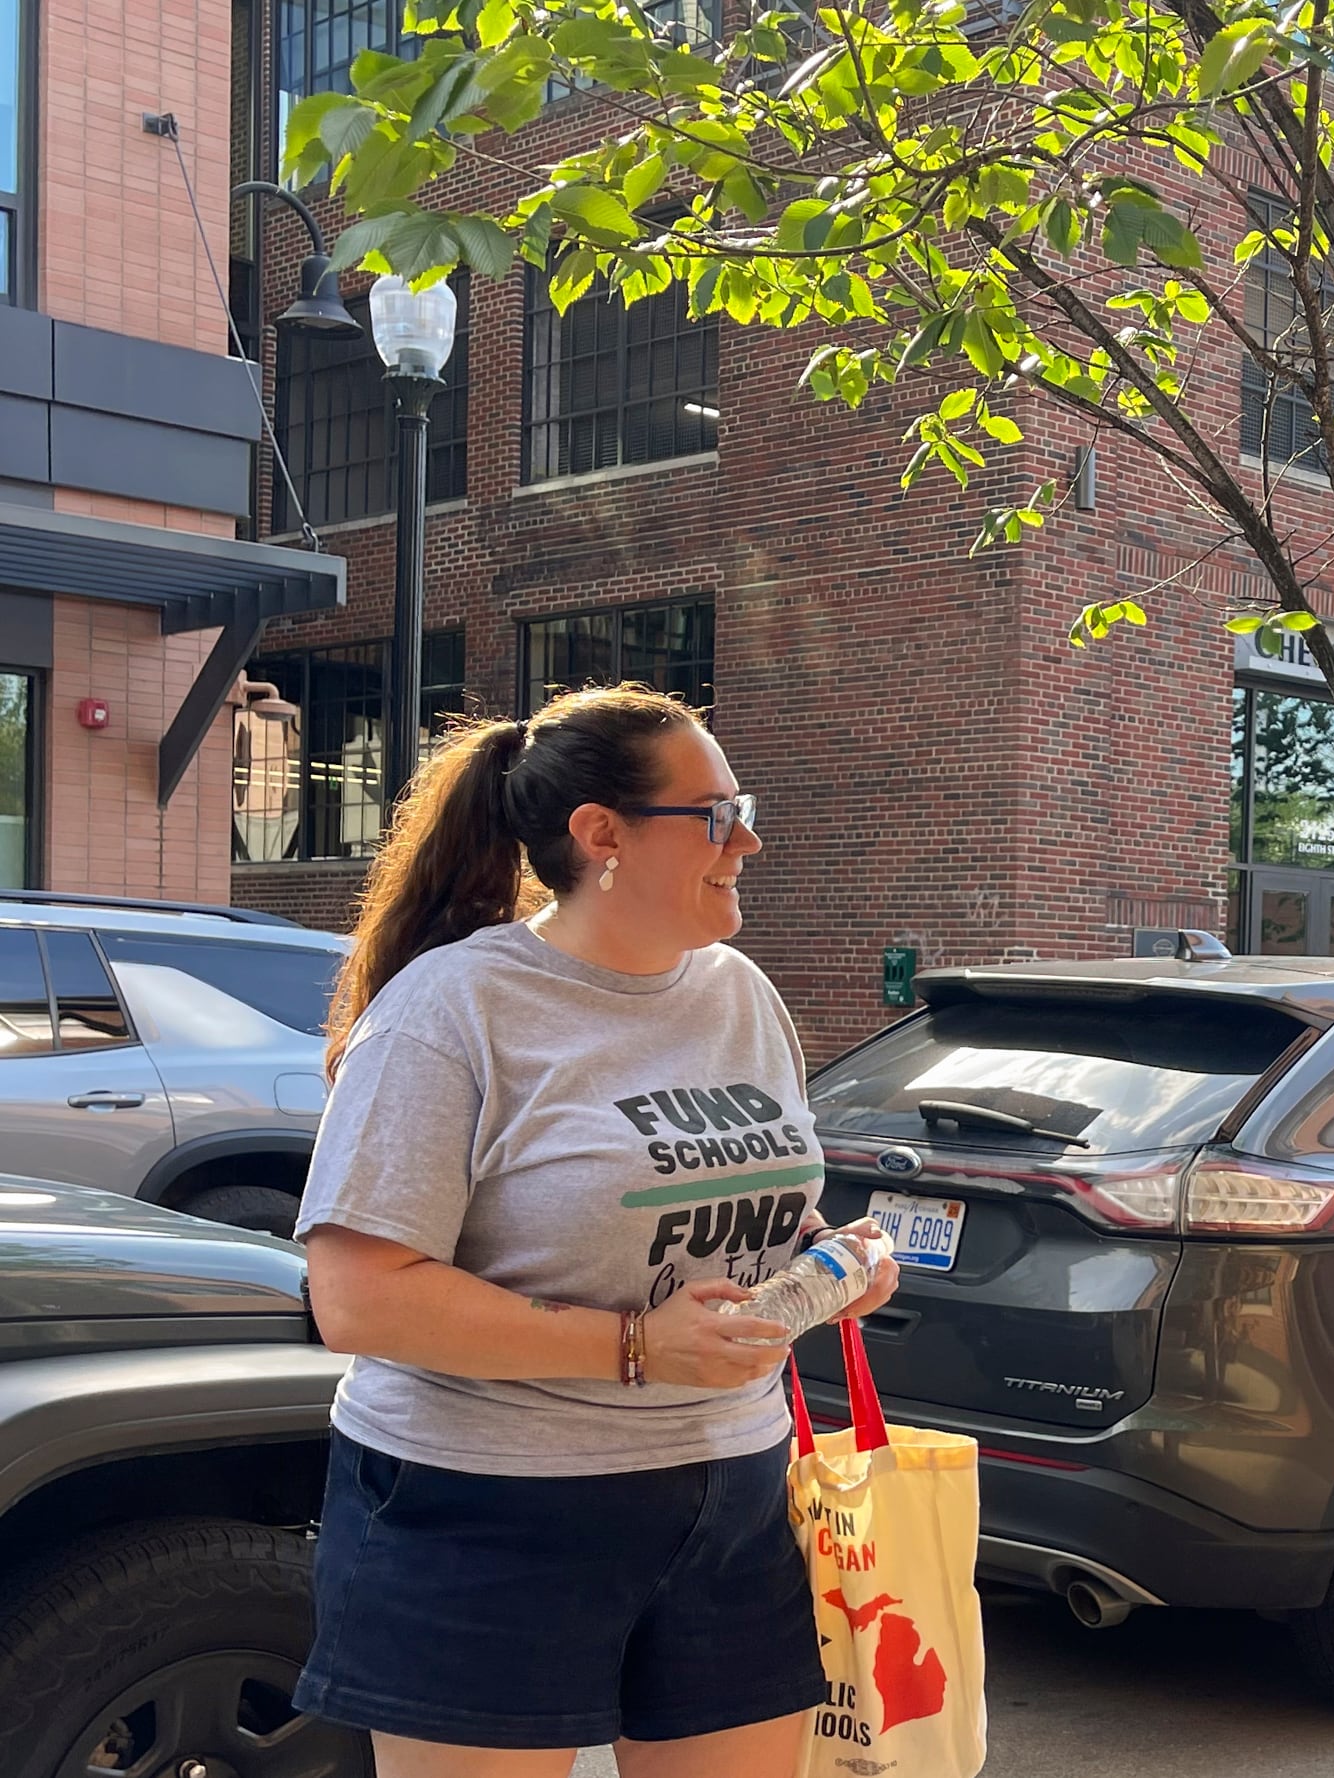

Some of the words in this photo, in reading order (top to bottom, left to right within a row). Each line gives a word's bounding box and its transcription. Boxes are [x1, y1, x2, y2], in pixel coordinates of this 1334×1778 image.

[1298, 842, 1327, 854] EIGHTH
[613, 1083, 783, 1136] FUND
[648, 1124, 808, 1175] SCHOOLS
[648, 1192, 807, 1267] FUND
[909, 1216, 954, 1252] 6809
[1004, 1377, 1125, 1400] TITANIUM
[835, 1510, 855, 1536] IN
